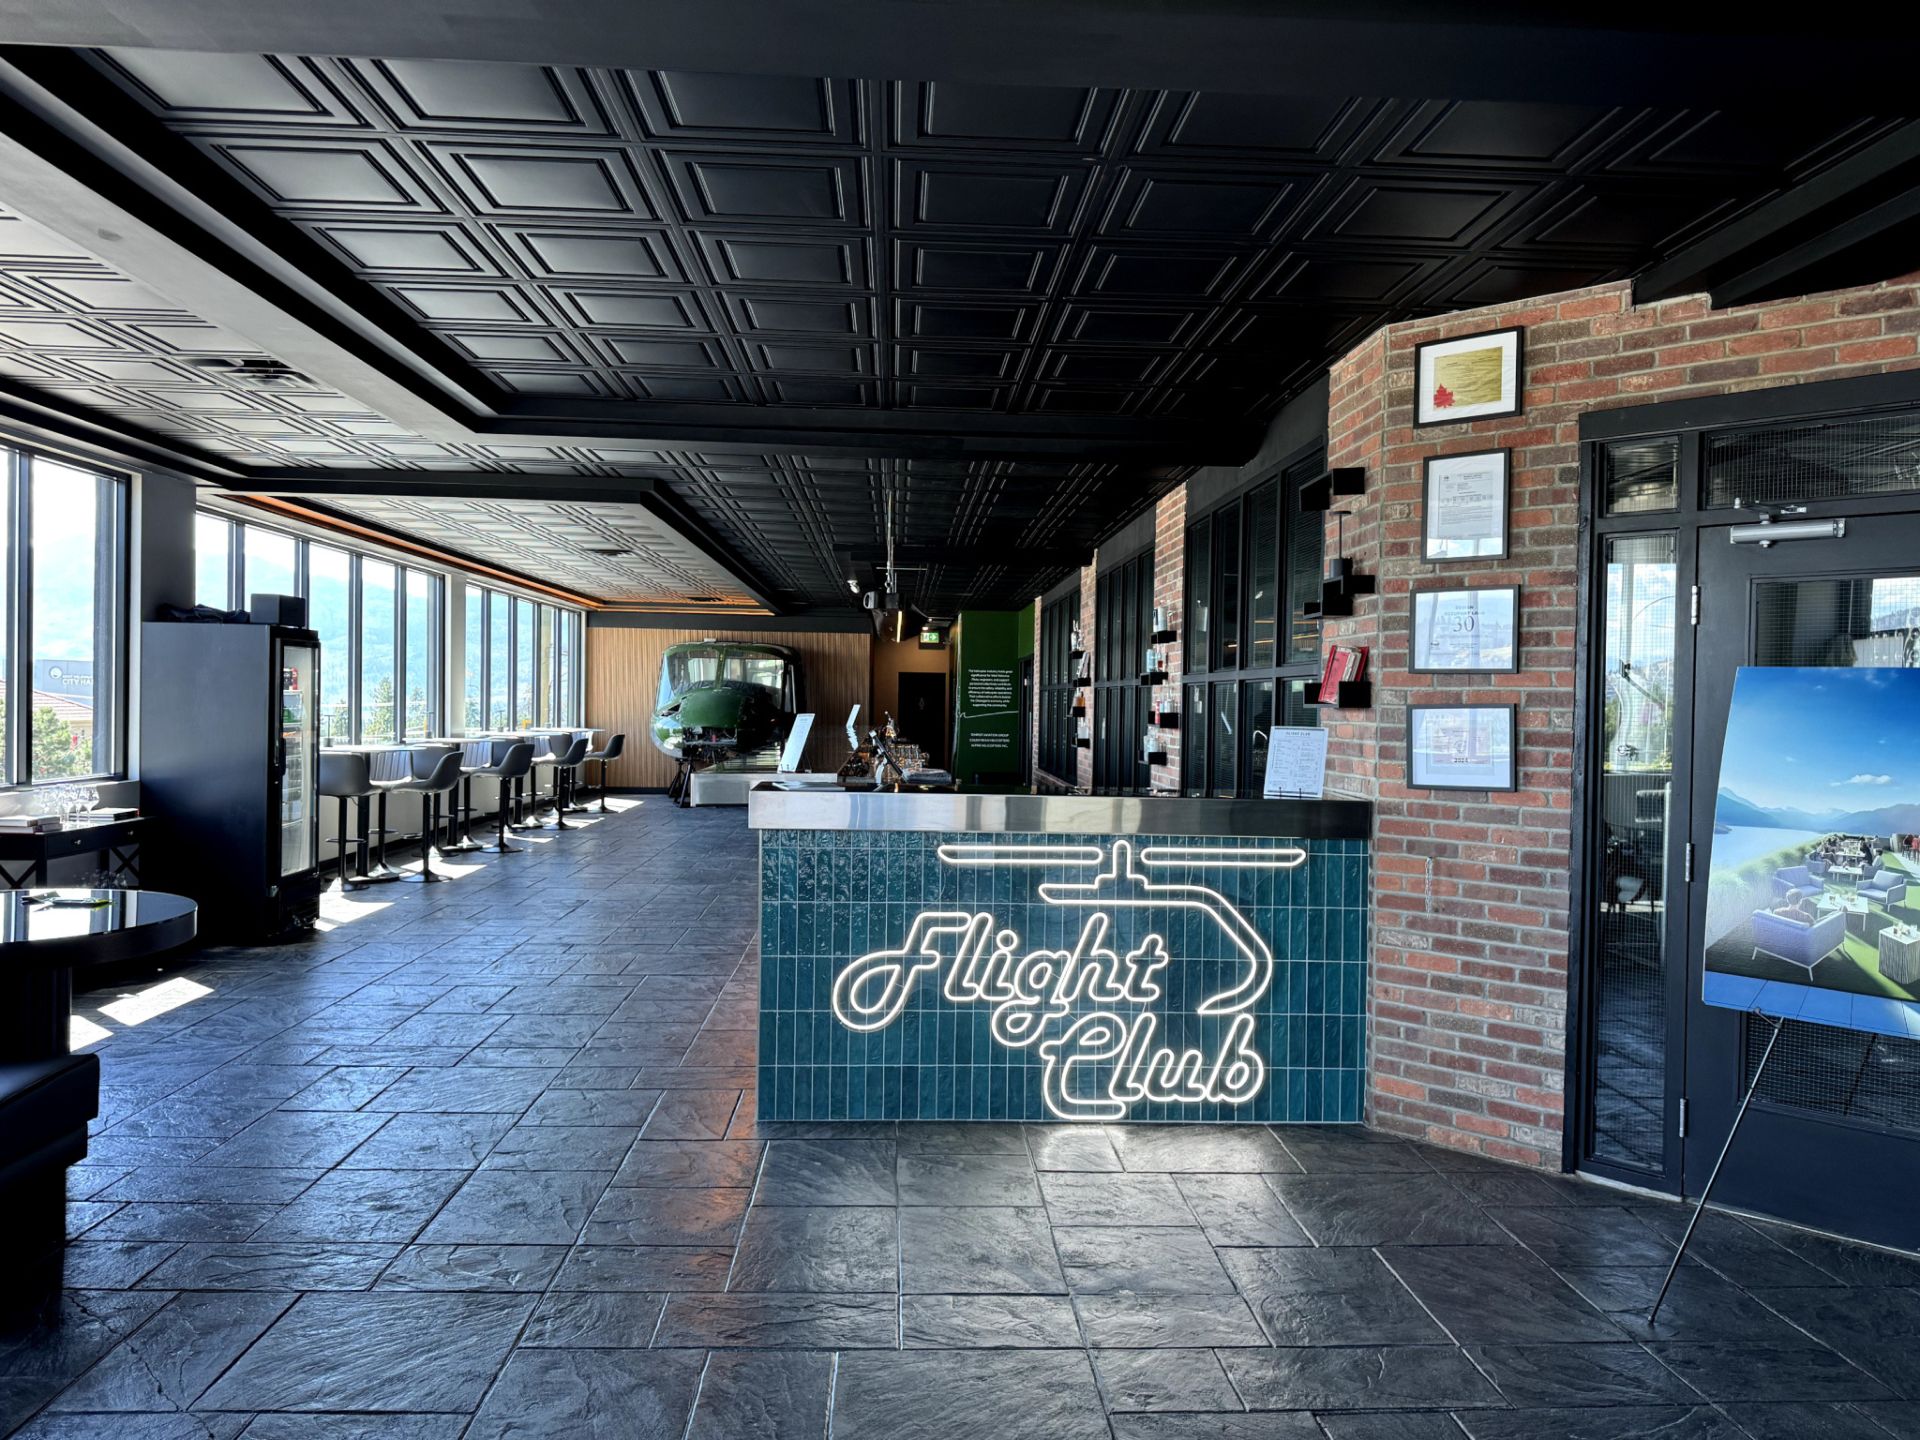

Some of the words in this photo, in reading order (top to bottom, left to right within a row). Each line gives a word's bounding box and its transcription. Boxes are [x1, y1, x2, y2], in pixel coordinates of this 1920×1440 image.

[1453, 615, 1475, 632] 30
[832, 911, 1169, 1047] Flight
[1040, 1011, 1265, 1121] Club
